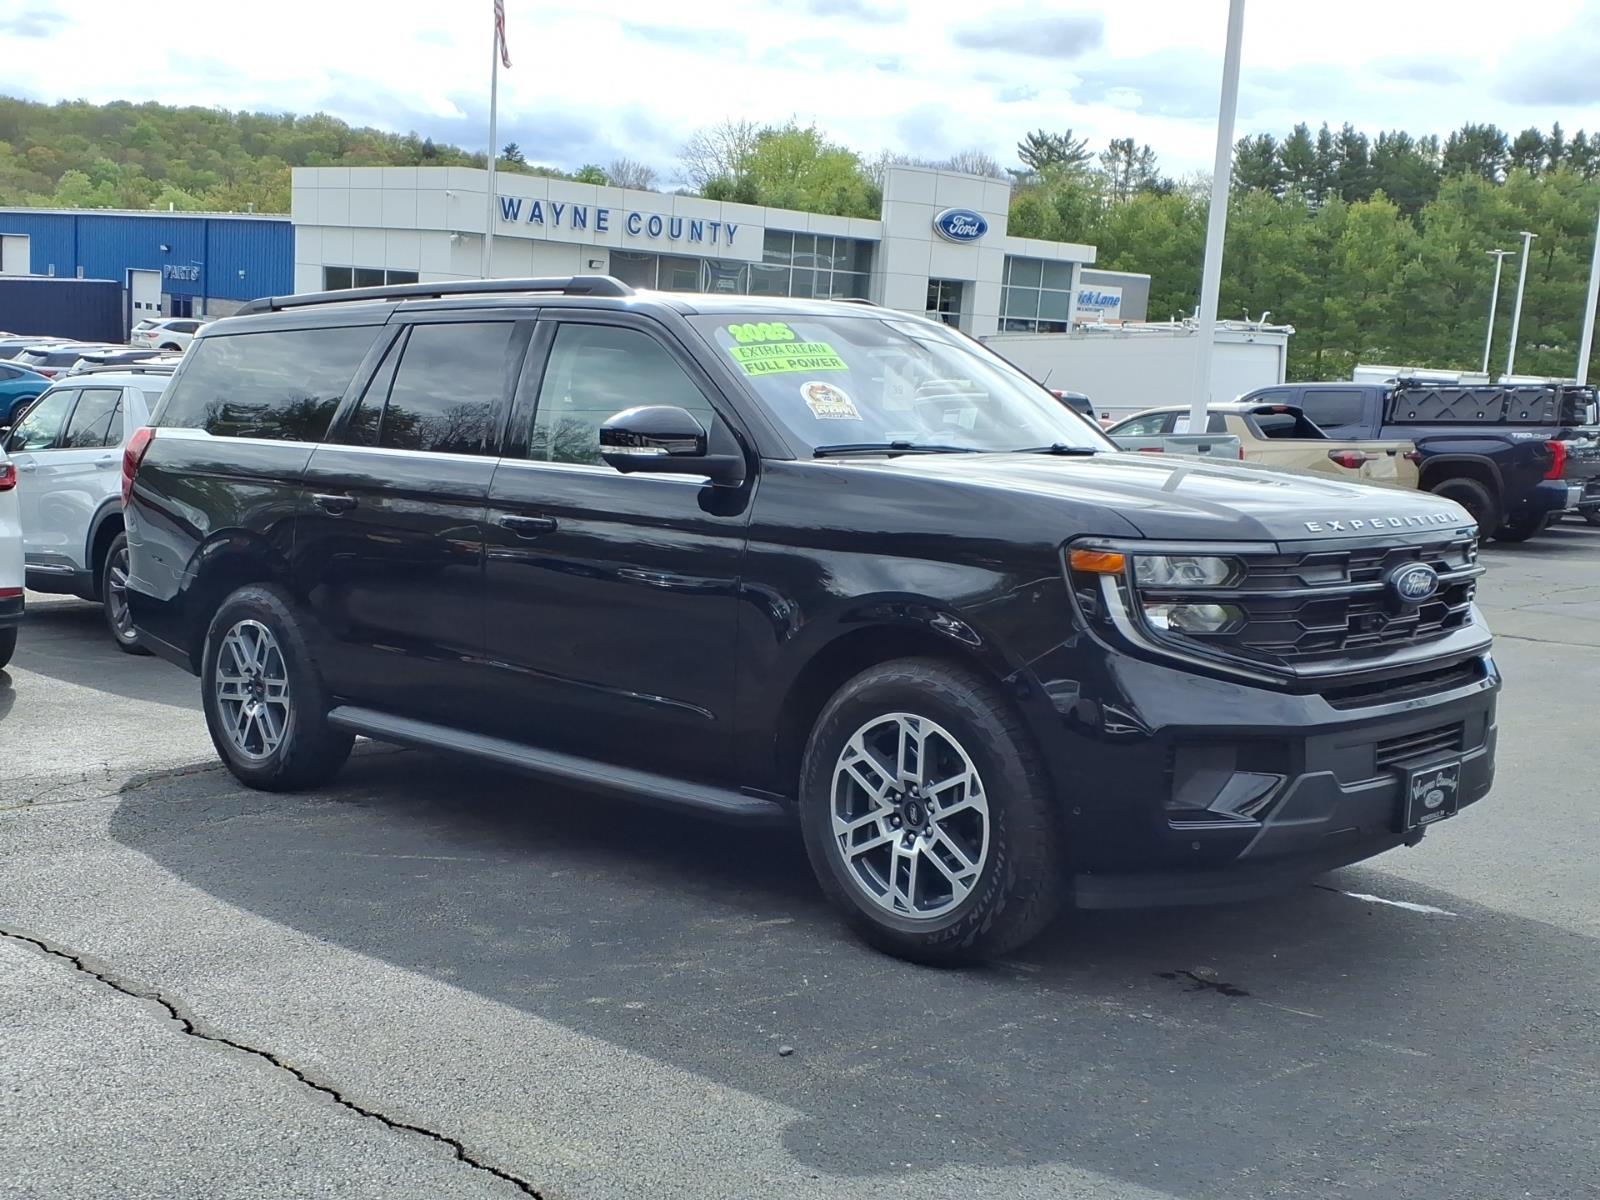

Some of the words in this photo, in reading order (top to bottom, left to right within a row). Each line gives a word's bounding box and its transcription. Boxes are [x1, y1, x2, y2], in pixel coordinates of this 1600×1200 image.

[500, 197, 609, 233] WAYNE
[627, 212, 739, 246] COUNTY
[949, 215, 980, 236] Ford
[163, 264, 200, 281] PARTS
[1095, 292, 1121, 307] Lane
[728, 322, 795, 343] 2025
[739, 345, 785, 358] EXTRA
[785, 343, 827, 355] CLEAN
[744, 361, 785, 374] FULL
[786, 357, 841, 369] POWER
[1303, 512, 1460, 533] EXPEDITION
[1406, 571, 1432, 596] Ford
